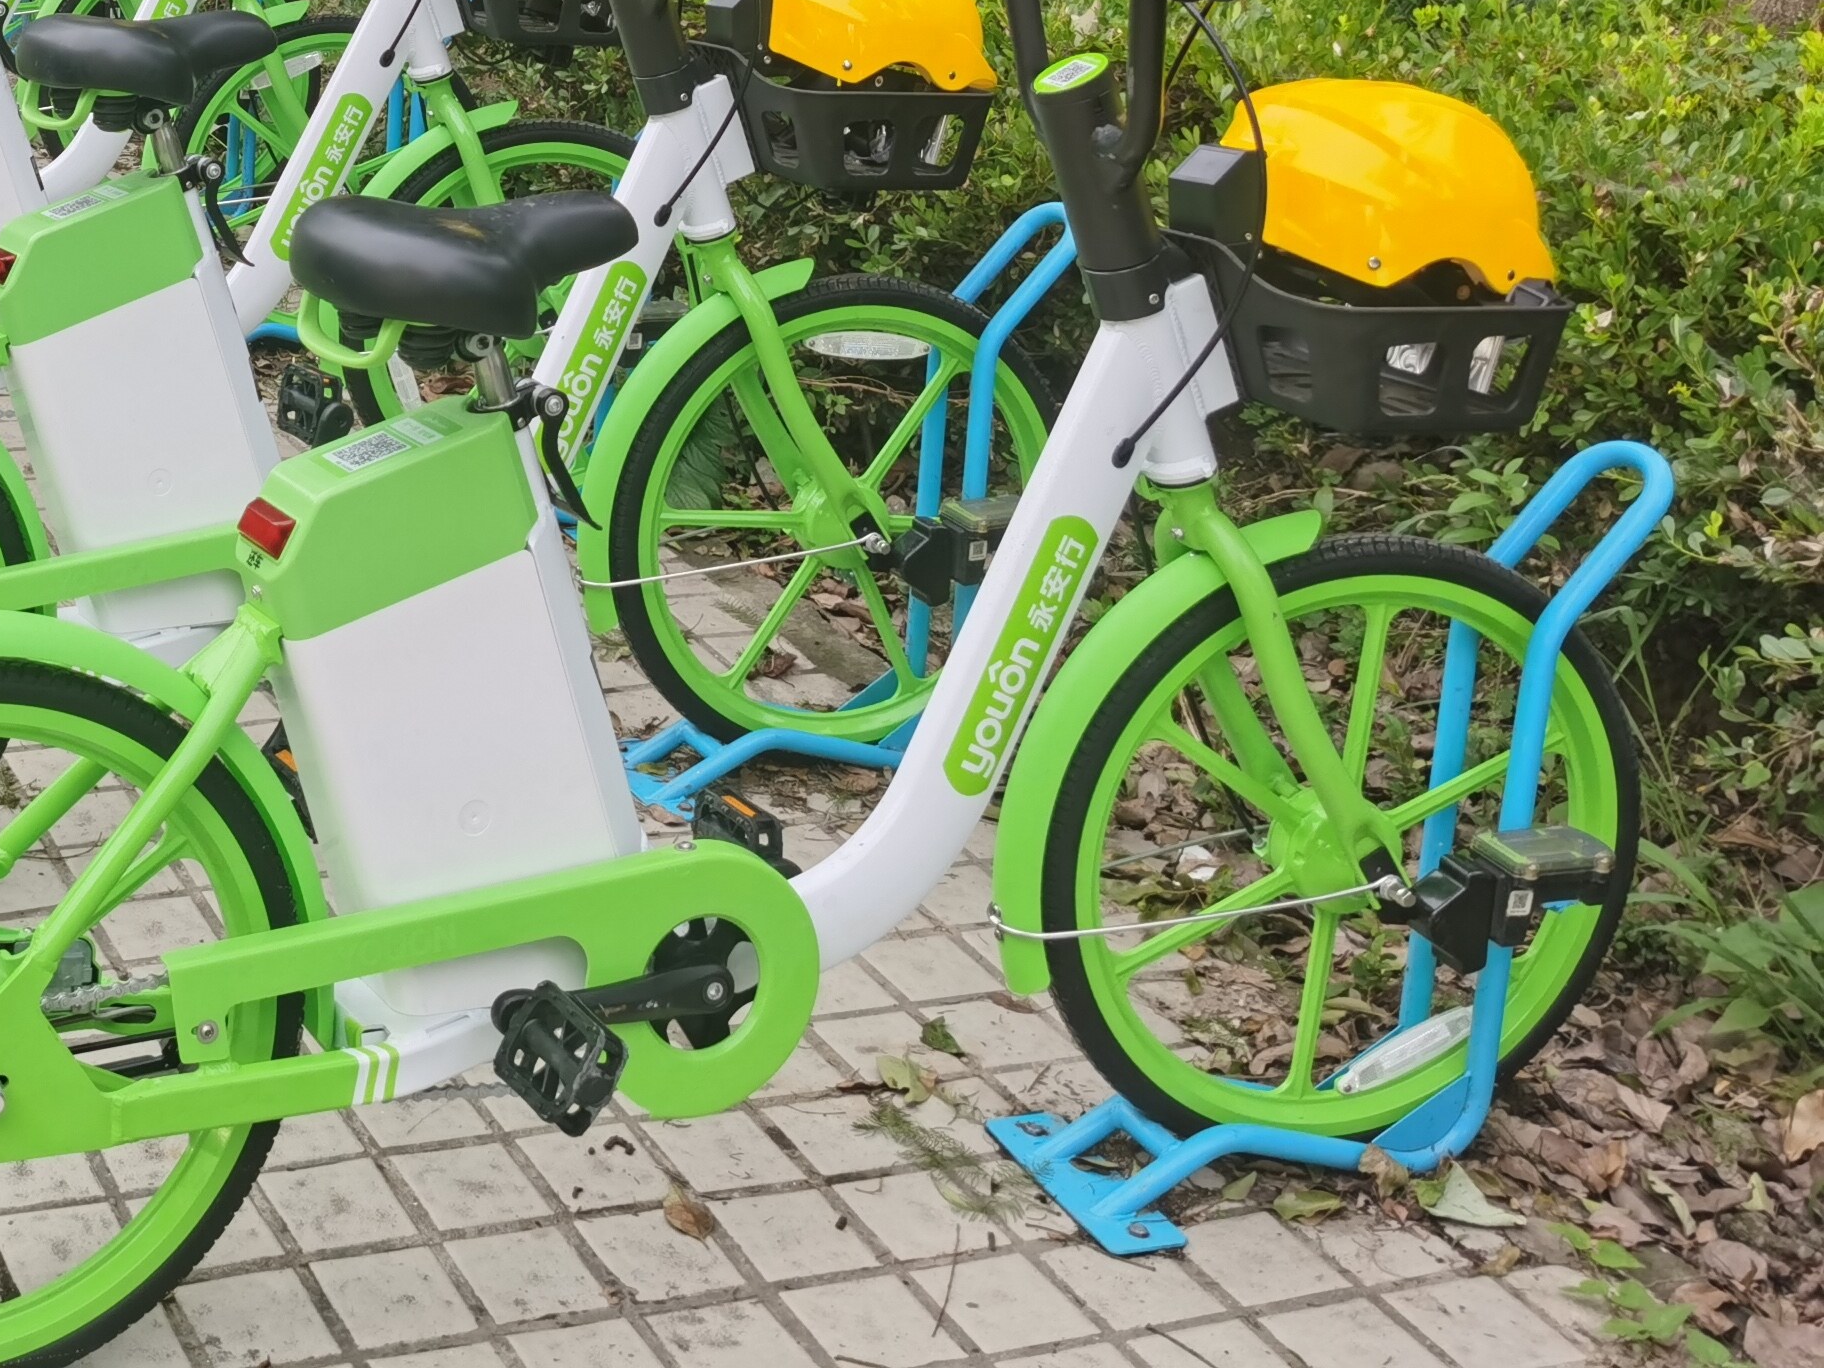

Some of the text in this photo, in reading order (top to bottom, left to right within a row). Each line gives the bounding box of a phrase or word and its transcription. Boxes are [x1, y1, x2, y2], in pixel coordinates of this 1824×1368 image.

[324, 104, 364, 165] 永安行
[592, 275, 638, 351] 永安行
[960, 534, 1086, 779] youôn 永安行
